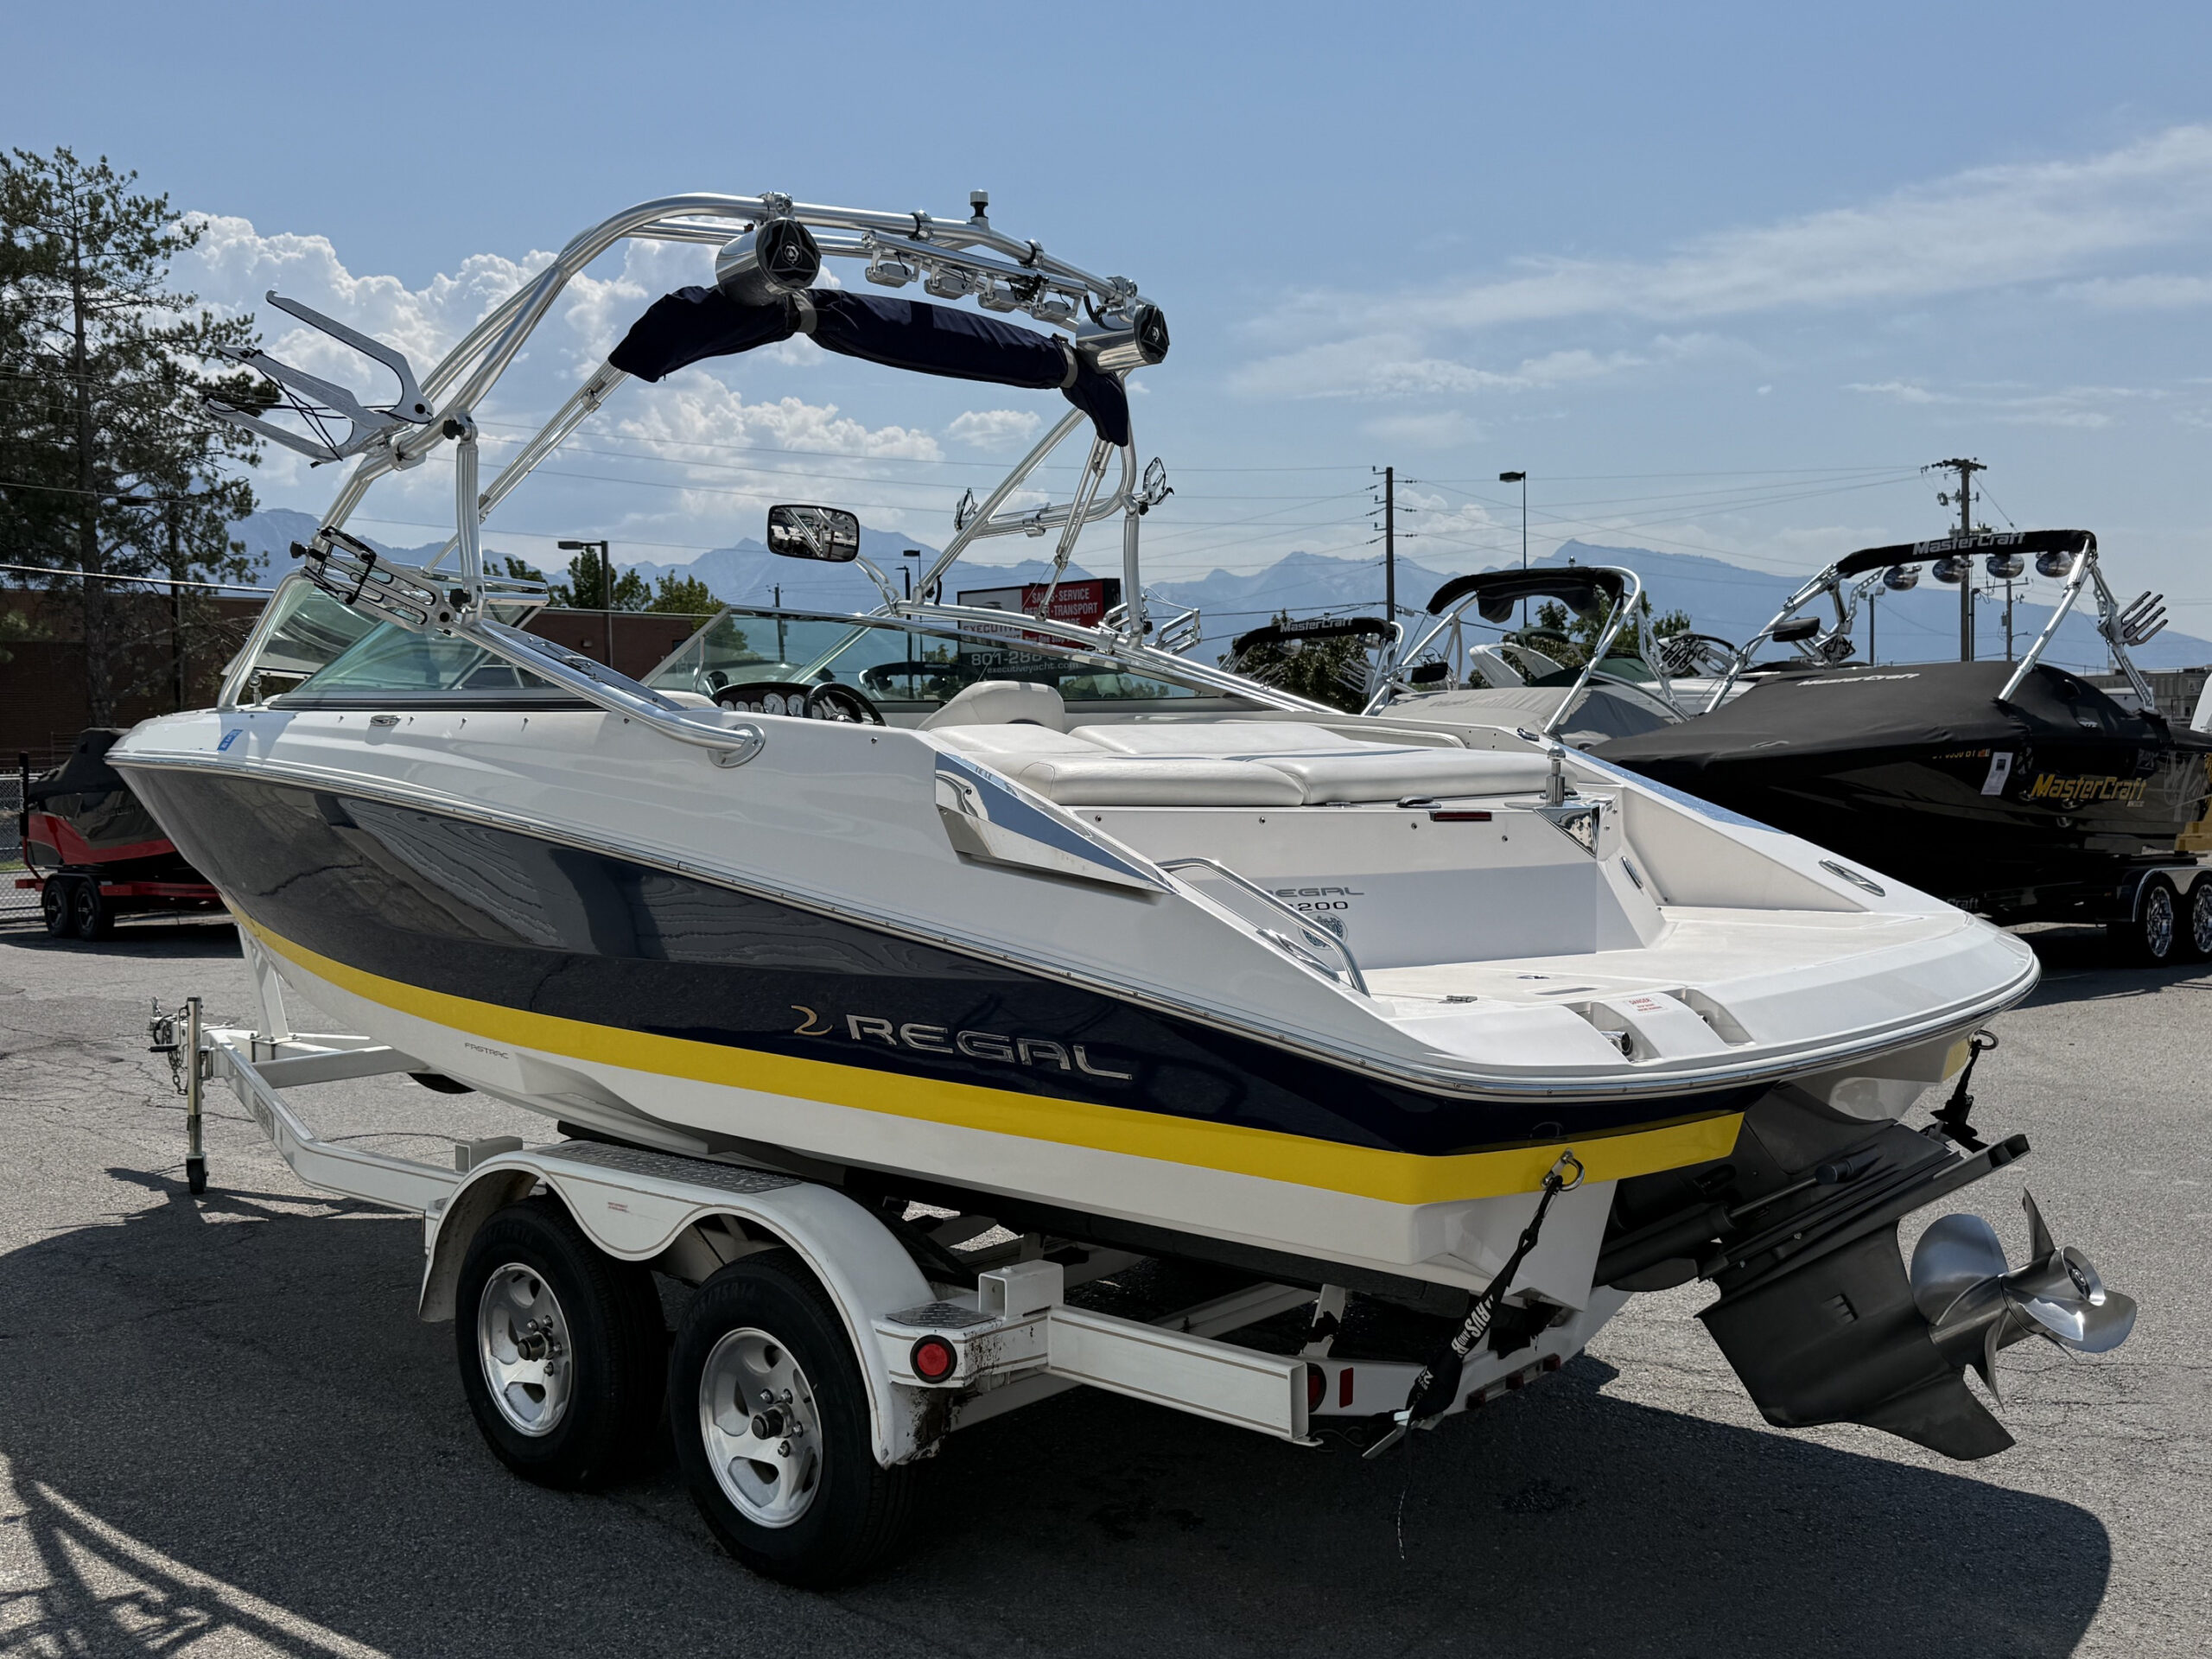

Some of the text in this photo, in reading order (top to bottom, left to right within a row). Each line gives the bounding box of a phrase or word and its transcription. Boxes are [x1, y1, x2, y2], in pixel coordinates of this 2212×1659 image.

[1912, 531, 2025, 556] MasterCraft
[1058, 588, 1090, 602] SERVICE
[1054, 602, 1097, 616] TRANSPORT
[1280, 618, 1353, 633] MasterCraft
[987, 661, 1079, 674] executiveyacht.com
[2031, 773, 2147, 801] MasterCraft
[1287, 900, 1348, 912] 200
[464, 1042, 510, 1059] FASTRAC
[846, 1014, 1133, 1080] REGAL
